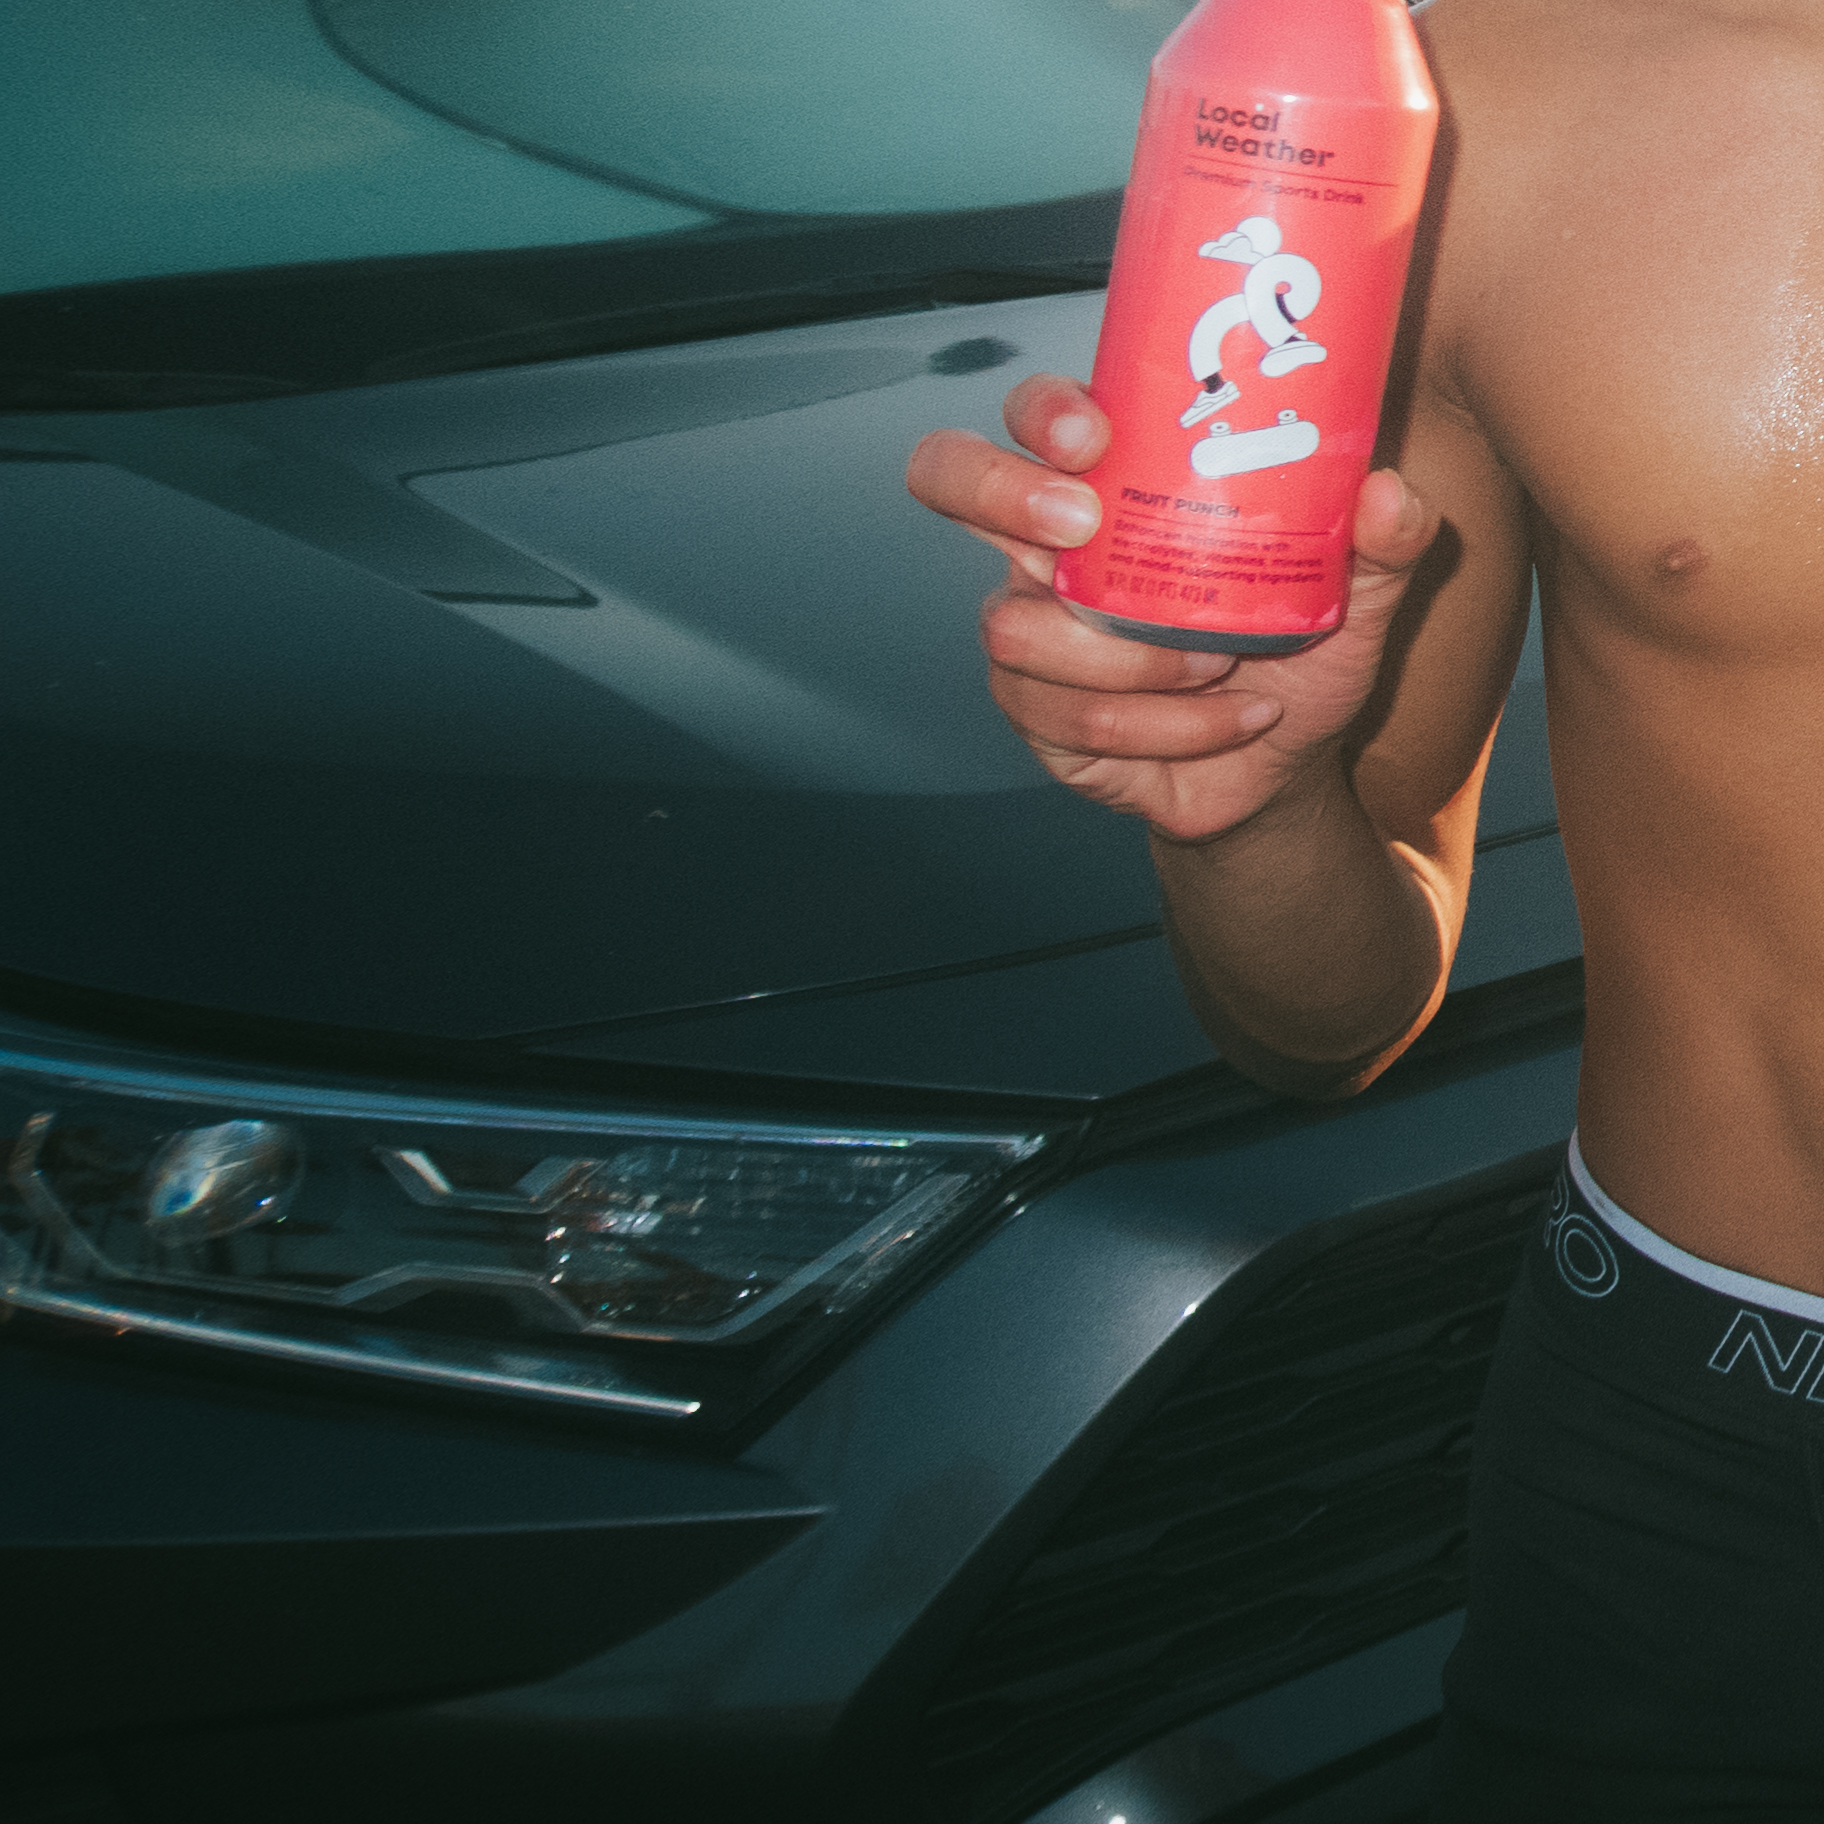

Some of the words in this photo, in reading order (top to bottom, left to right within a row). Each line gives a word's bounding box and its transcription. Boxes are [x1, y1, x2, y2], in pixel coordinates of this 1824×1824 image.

[1196, 97, 1280, 132] Local
[1194, 123, 1335, 167] Weather
[1260, 179, 1319, 200] Sports
[1121, 487, 1171, 506] FRUIT
[1174, 498, 1241, 518] PUNCH
